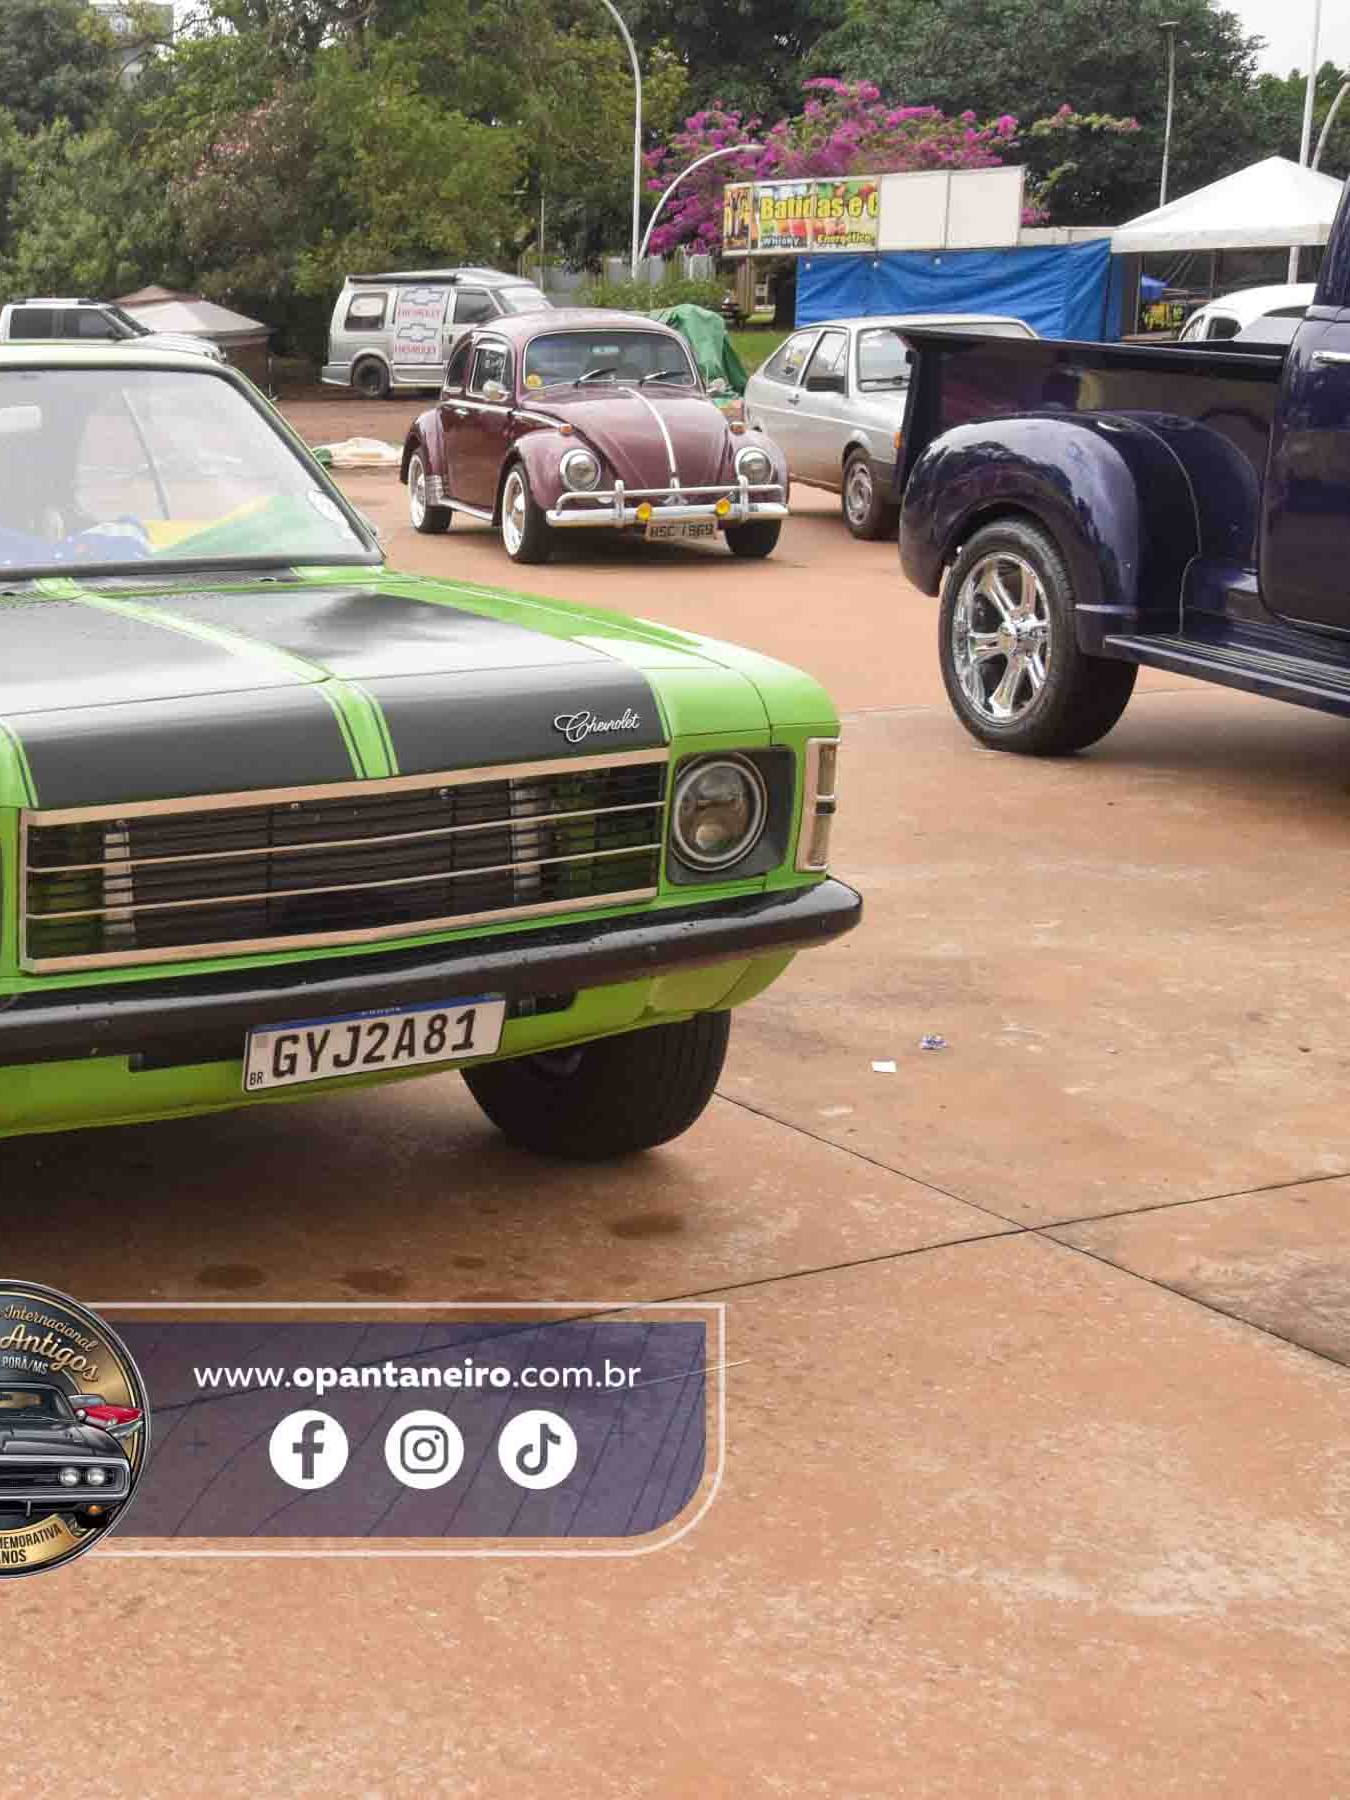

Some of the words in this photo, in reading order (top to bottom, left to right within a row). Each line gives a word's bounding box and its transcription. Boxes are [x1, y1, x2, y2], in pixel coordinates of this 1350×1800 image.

[554, 708, 640, 742] Chevrolet
[272, 1008, 476, 1078] GYJ2A81
[249, 1071, 264, 1086] BR
